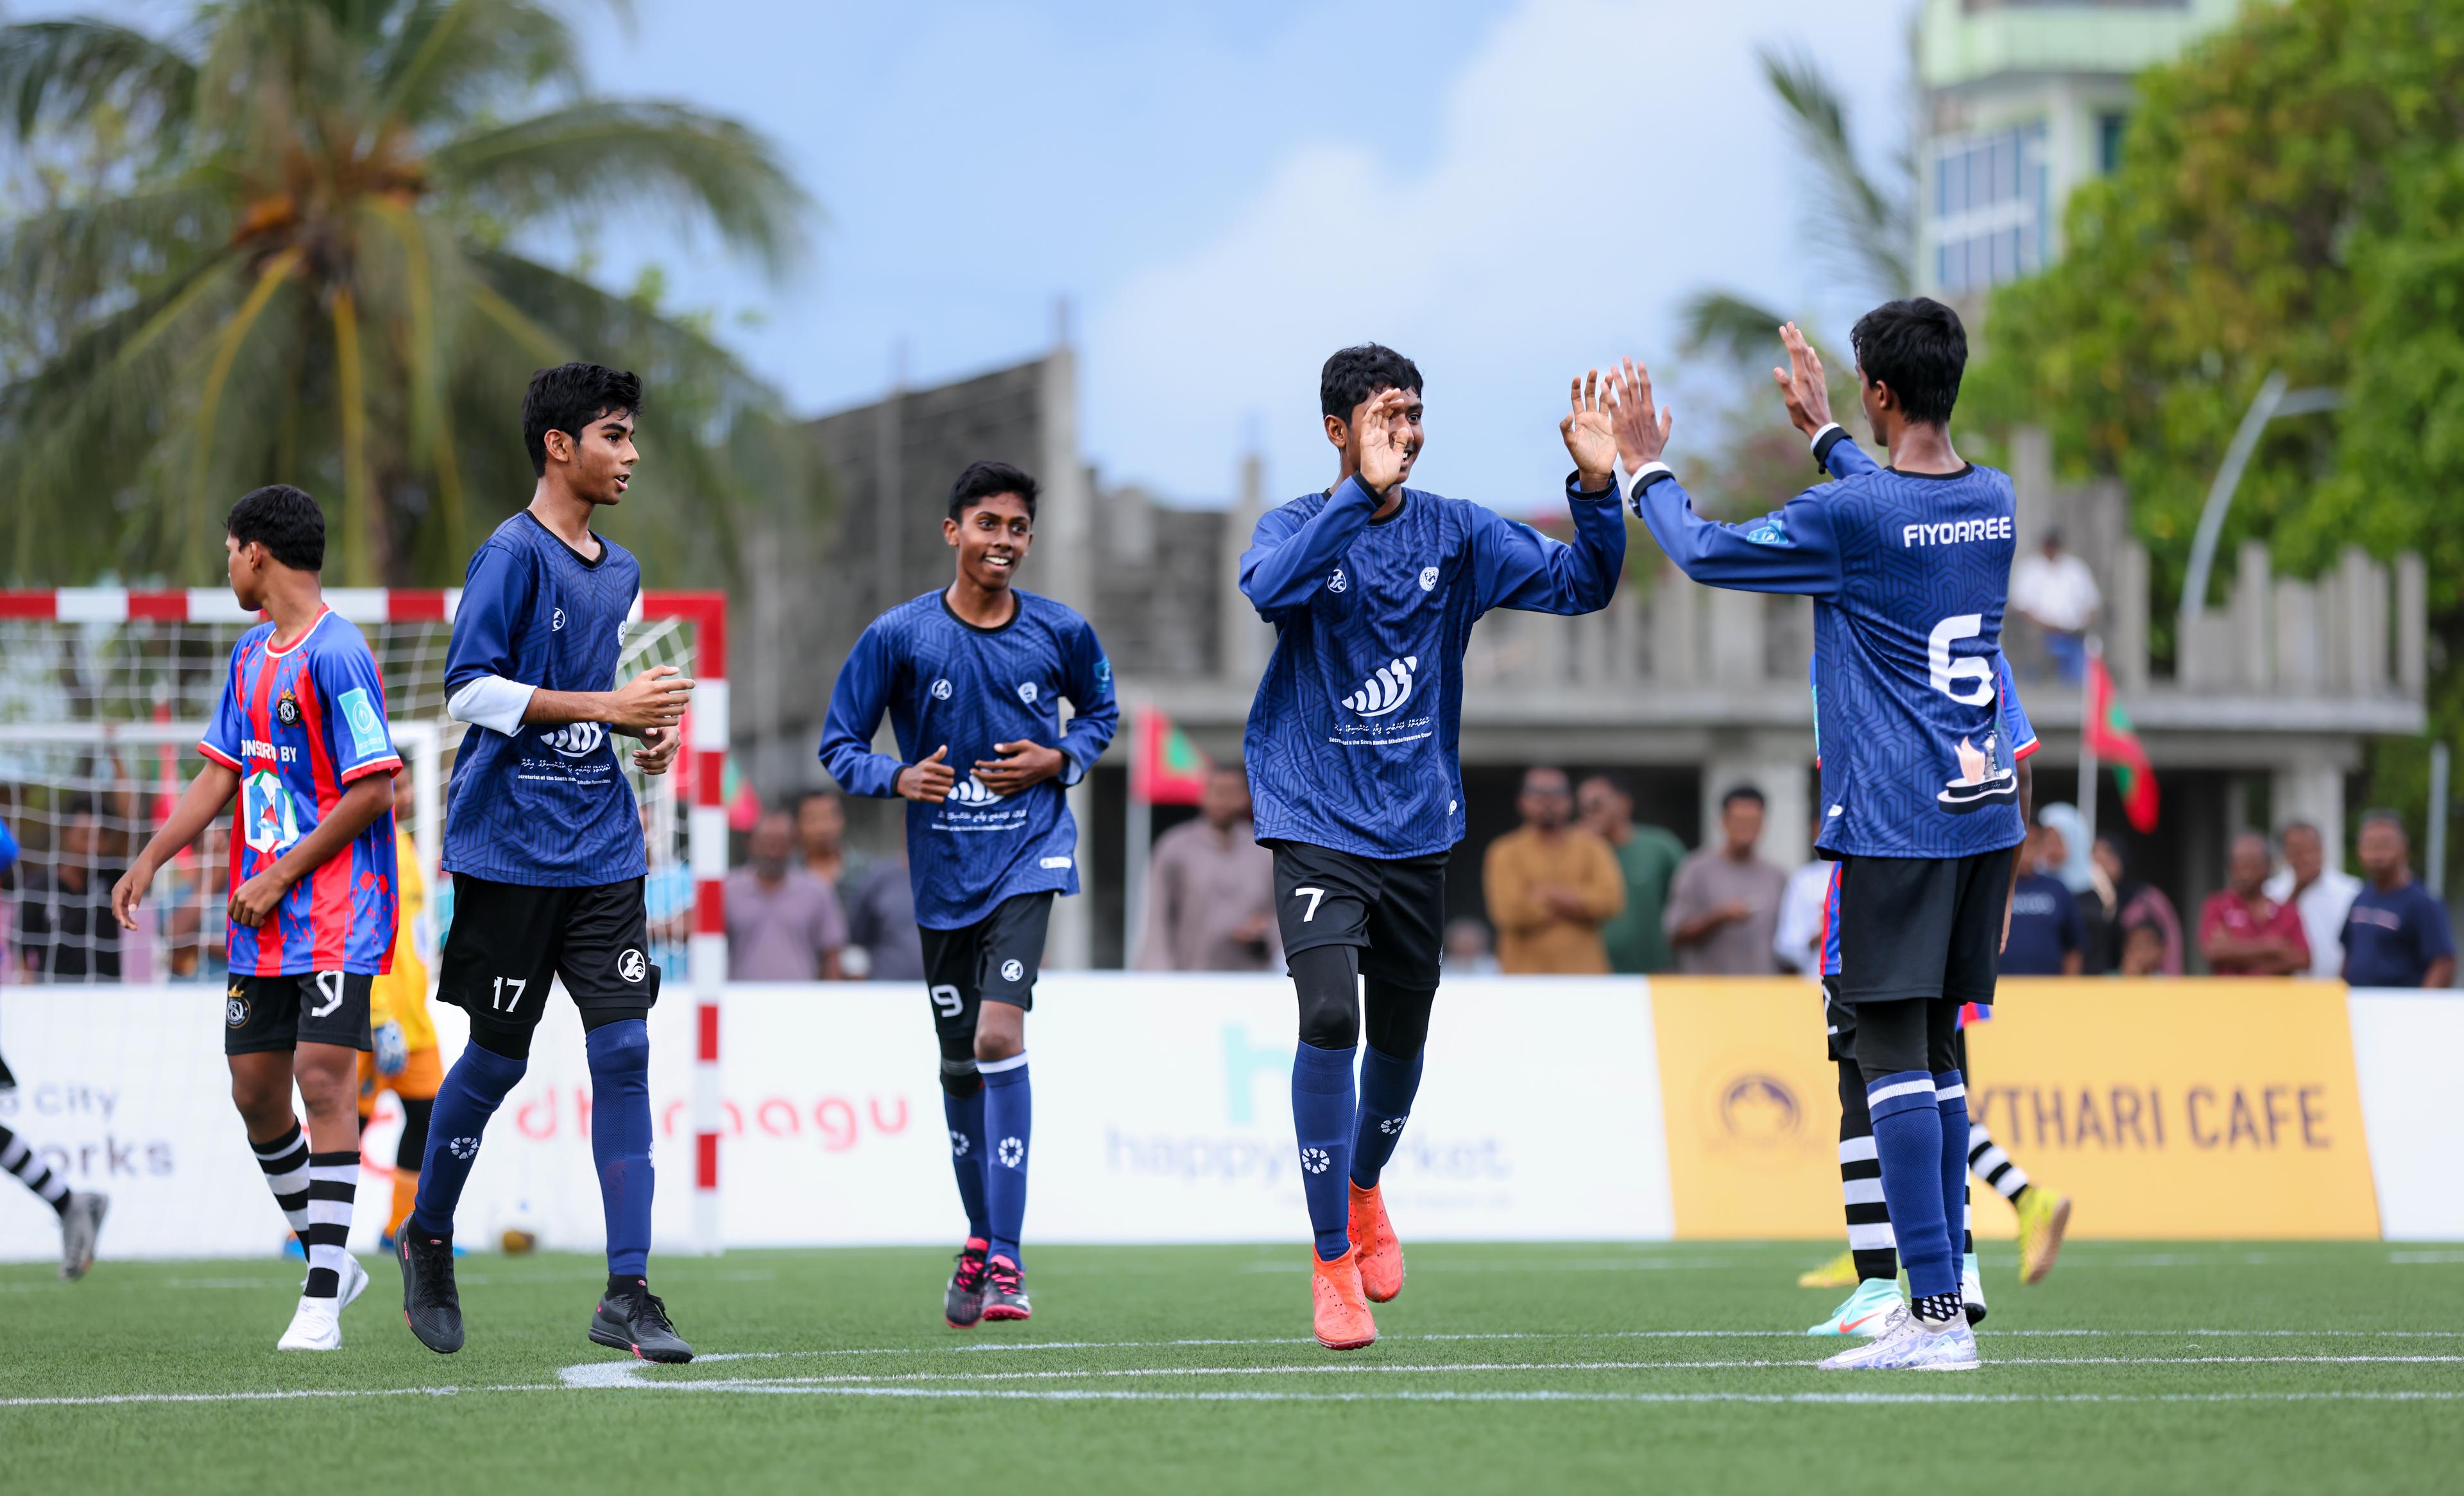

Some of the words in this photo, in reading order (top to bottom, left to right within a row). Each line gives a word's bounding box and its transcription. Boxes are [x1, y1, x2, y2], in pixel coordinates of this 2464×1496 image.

[1903, 517, 2011, 547] FIYOAREE
[1928, 614, 1995, 707] 6
[280, 746, 296, 762] BY
[1295, 887, 1326, 922] 7
[493, 977, 526, 1012] 17
[930, 984, 963, 1017] 9
[2188, 1085, 2333, 1149] CAFE
